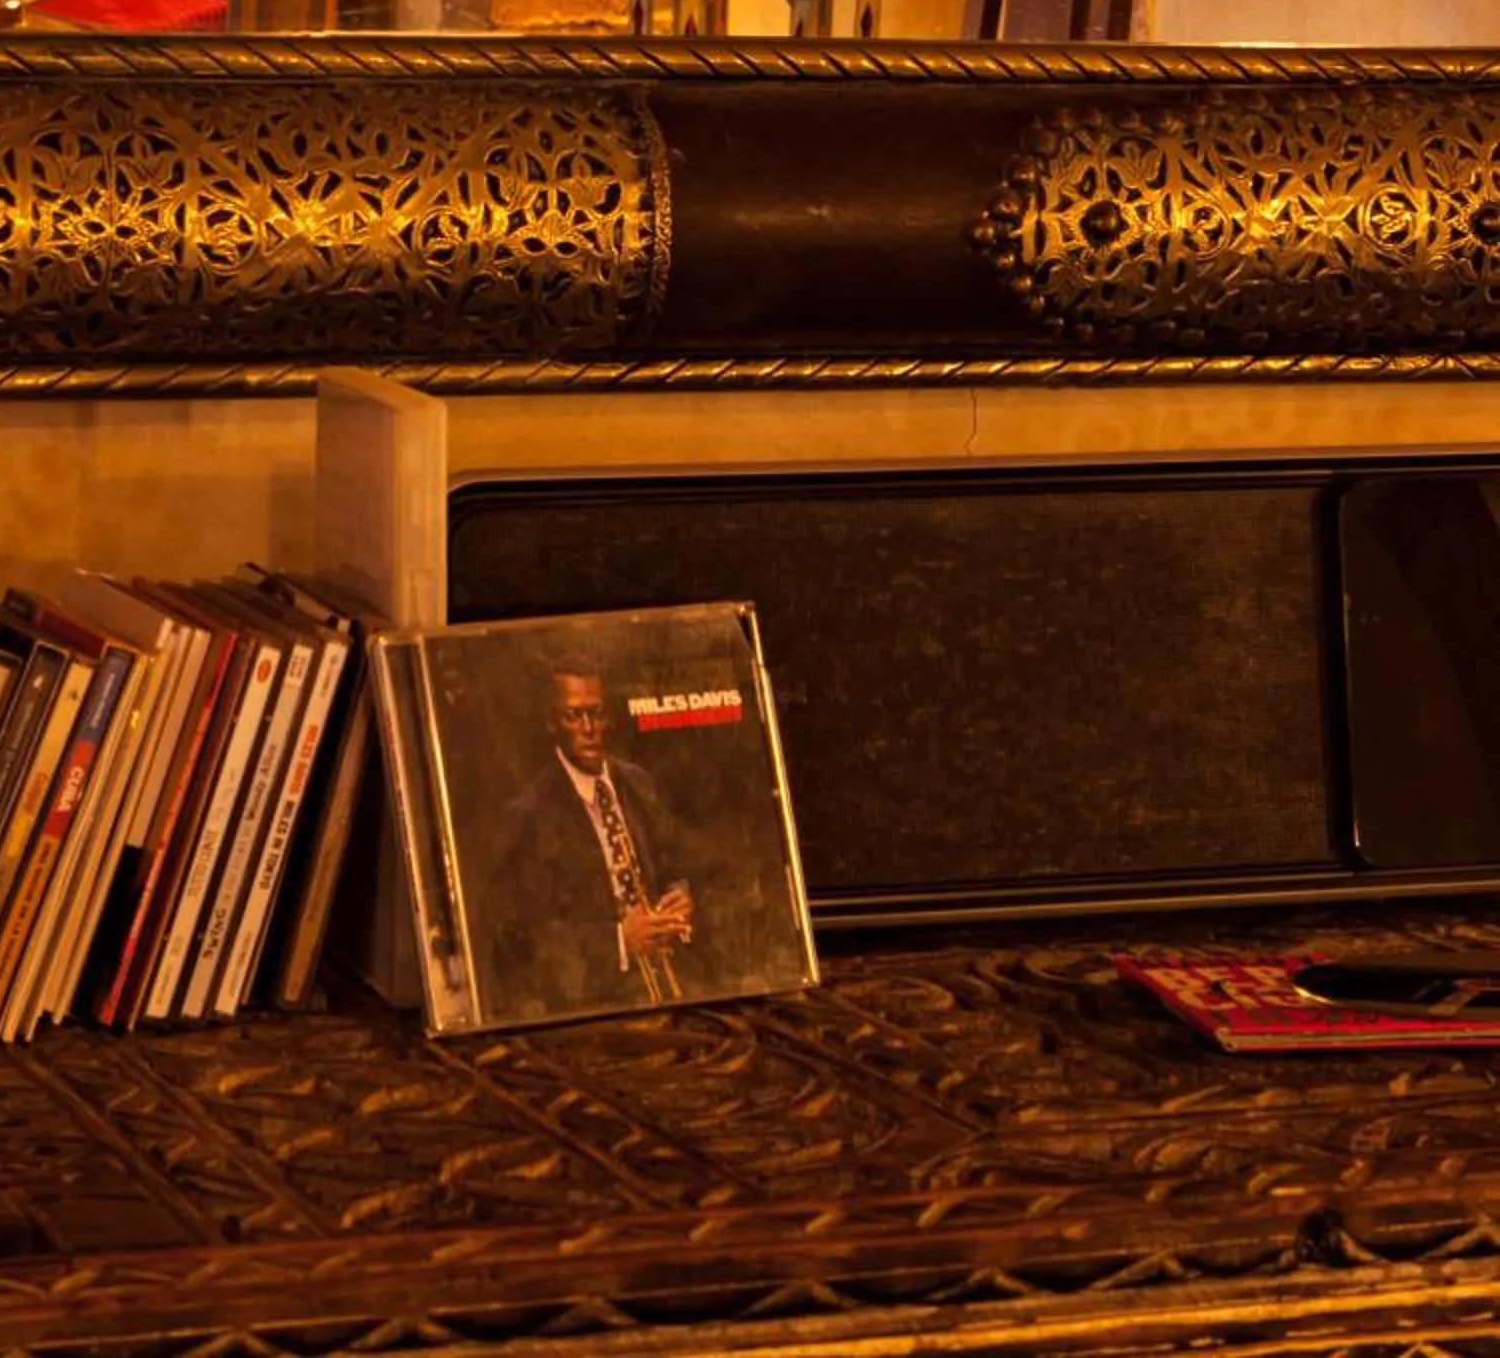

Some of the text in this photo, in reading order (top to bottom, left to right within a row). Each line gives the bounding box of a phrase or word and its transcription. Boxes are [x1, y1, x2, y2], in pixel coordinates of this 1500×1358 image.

[628, 689, 742, 717] MILES DAVIS
[57, 766, 84, 812] CUBA
[276, 800, 296, 835] MILES
[260, 851, 280, 890] TOKYO
[201, 908, 226, 959] SWING
